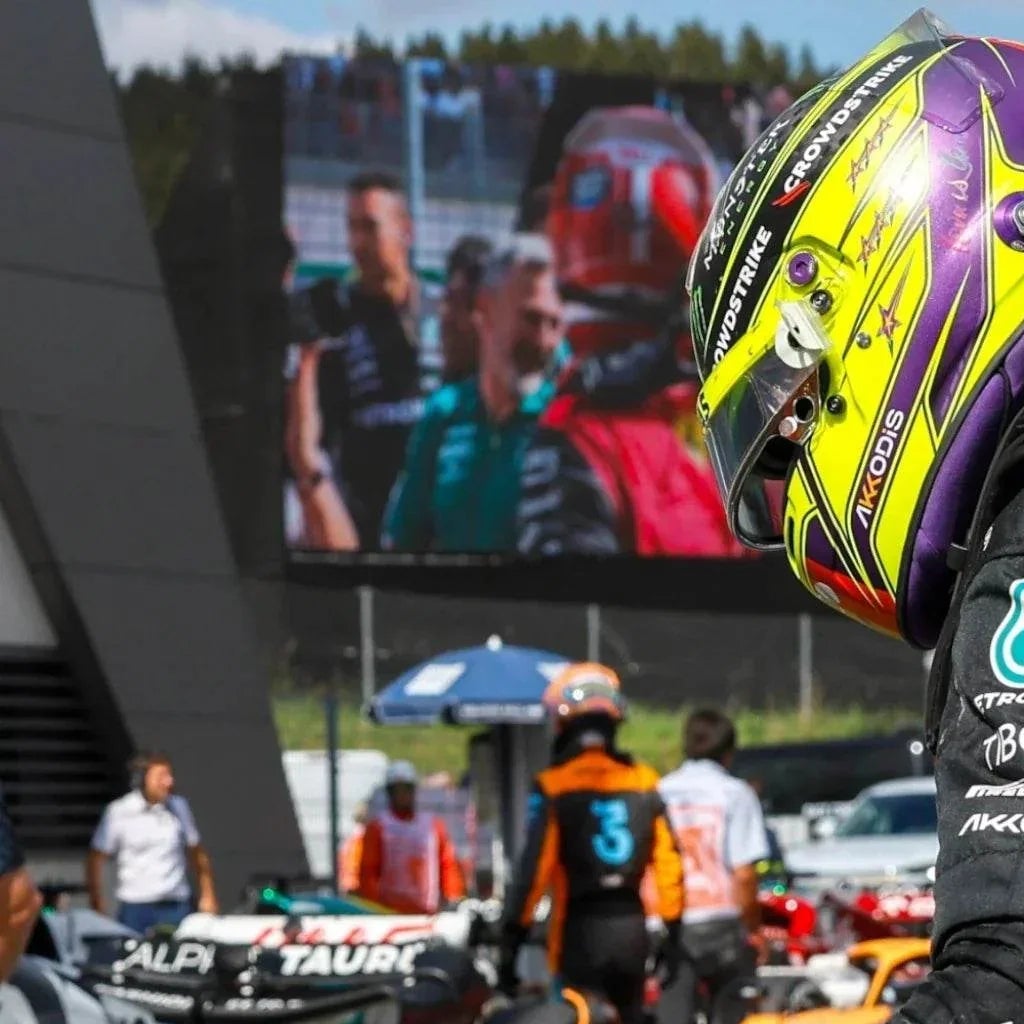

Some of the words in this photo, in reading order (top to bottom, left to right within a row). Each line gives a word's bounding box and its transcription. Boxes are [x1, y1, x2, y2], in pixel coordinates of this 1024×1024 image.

[784, 54, 914, 194] CROWDSTRIKE
[711, 225, 774, 369] OWDSTRIKE
[589, 799, 635, 866] 3
